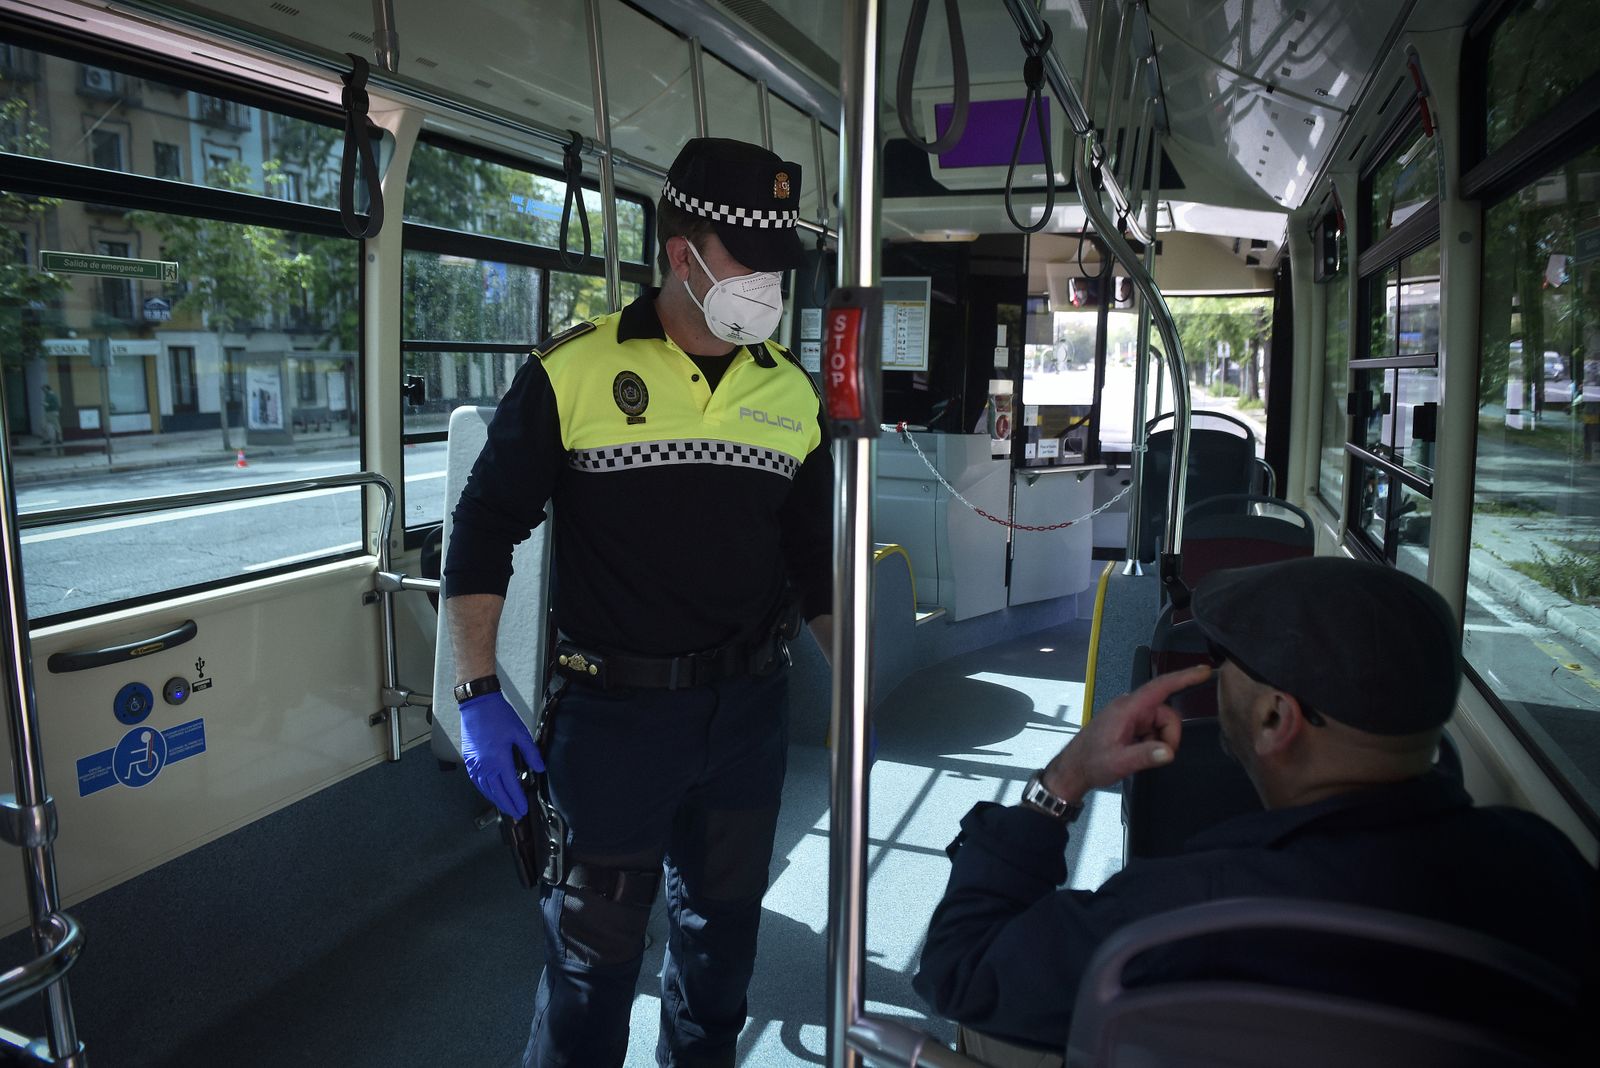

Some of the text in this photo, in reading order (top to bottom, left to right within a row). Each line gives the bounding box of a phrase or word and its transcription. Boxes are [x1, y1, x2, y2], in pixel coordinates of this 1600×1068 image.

[63, 258, 144, 273] Salida de emergencia
[830, 314, 848, 388] STOP
[739, 406, 804, 434] POLICIA
